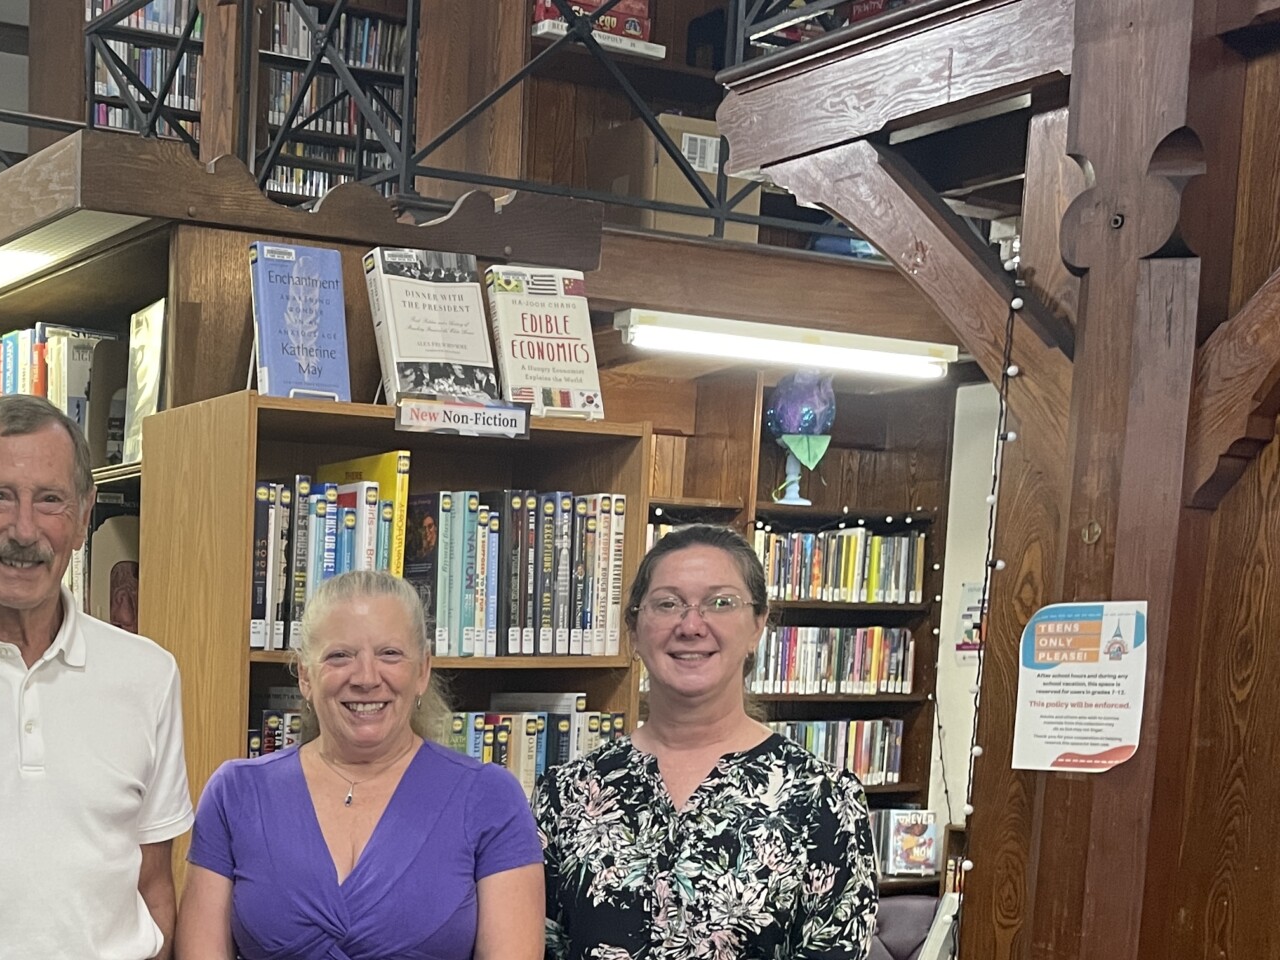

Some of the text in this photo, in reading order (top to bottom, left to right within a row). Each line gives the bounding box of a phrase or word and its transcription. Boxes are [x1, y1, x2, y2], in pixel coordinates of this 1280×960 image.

[268, 270, 340, 290] Enchantment
[405, 290, 464, 302] DINNER WITH
[402, 300, 470, 313] THE PRESIDENT
[521, 312, 570, 335] EDIBLE
[281, 343, 336, 360] Katherine
[512, 339, 590, 363] ECONOMICS
[298, 362, 322, 378] May
[410, 408, 517, 428] New Non-Fiction
[296, 531, 309, 568] GHOSTS
[323, 514, 337, 572] THIS OR DIE!
[543, 523, 554, 573] EXCEPTIONS
[612, 564, 623, 605] REVOLUTION
[575, 600, 583, 629] DeSant
[599, 595, 608, 629] SLEEPER
[1039, 623, 1079, 633] TEENS
[1040, 638, 1072, 647] ONLY
[1039, 652, 1087, 661] PLEASE!
[1046, 701, 1068, 709] policy
